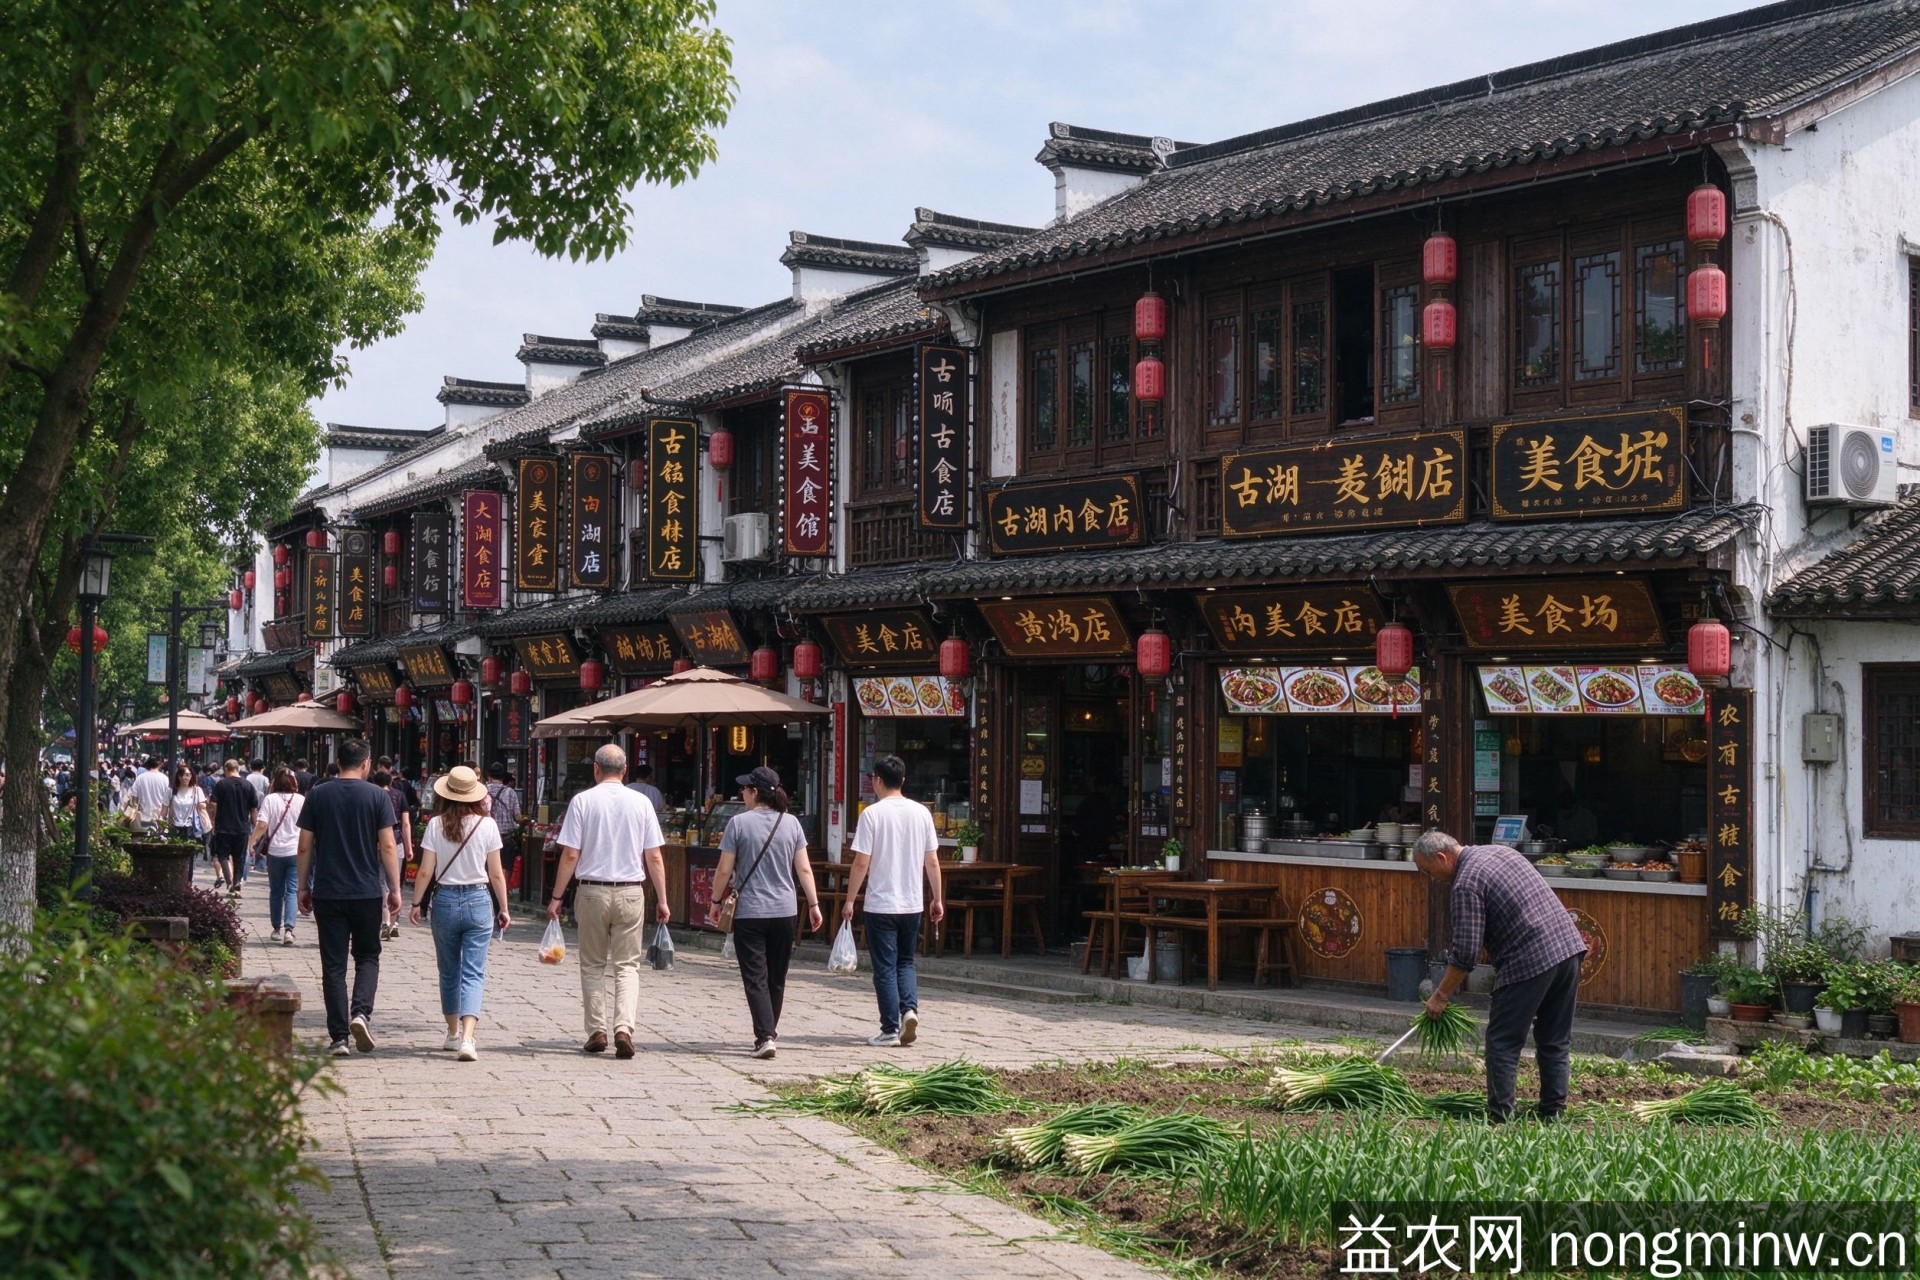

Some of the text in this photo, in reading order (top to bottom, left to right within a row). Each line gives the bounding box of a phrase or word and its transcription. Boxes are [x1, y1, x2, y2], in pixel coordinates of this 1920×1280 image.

[347, 566, 366, 620] 美食店
[1497, 594, 1618, 636] 美食场
[854, 622, 923, 654] 美食店
